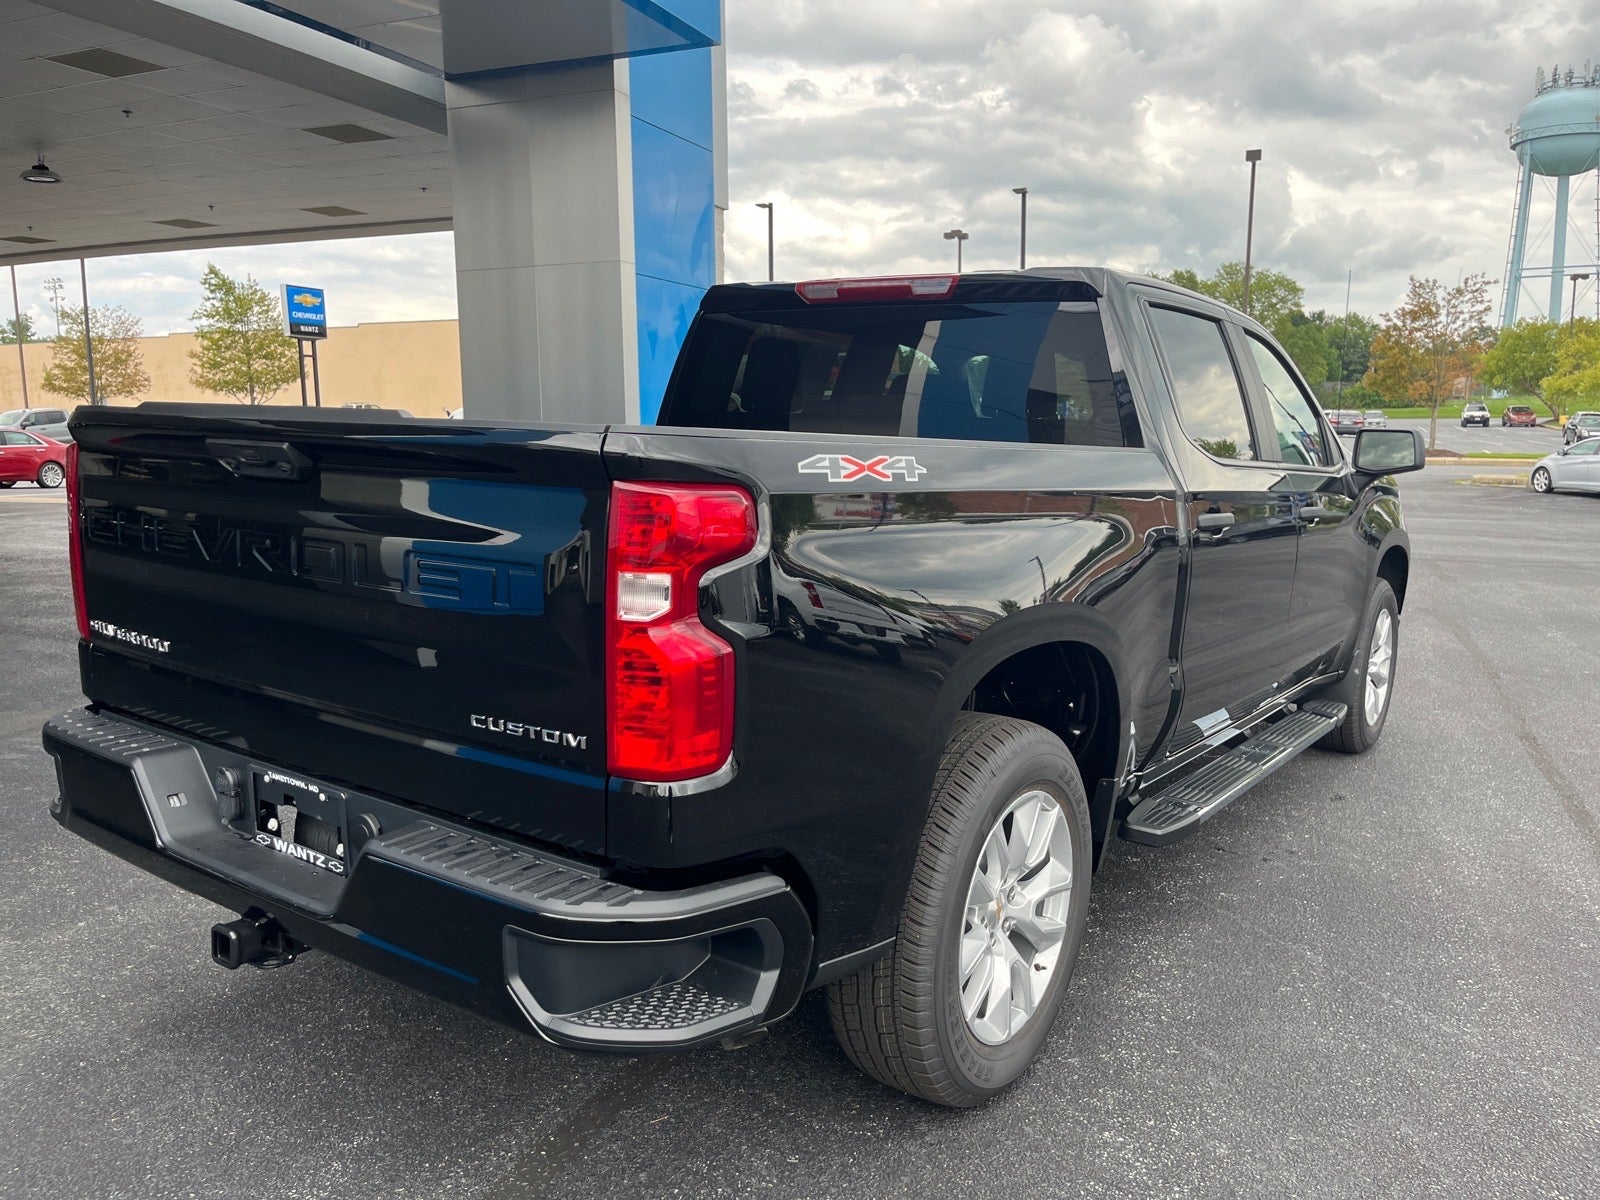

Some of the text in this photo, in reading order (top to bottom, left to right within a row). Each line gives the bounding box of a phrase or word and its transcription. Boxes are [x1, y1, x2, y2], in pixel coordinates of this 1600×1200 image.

[292, 311, 324, 320] CHEVROLET
[300, 325, 319, 333] WANTZ
[85, 505, 539, 608] CHEVROLET
[470, 714, 587, 750] CUSTOM
[308, 783, 320, 793] MD
[273, 837, 327, 868] WANTZ
